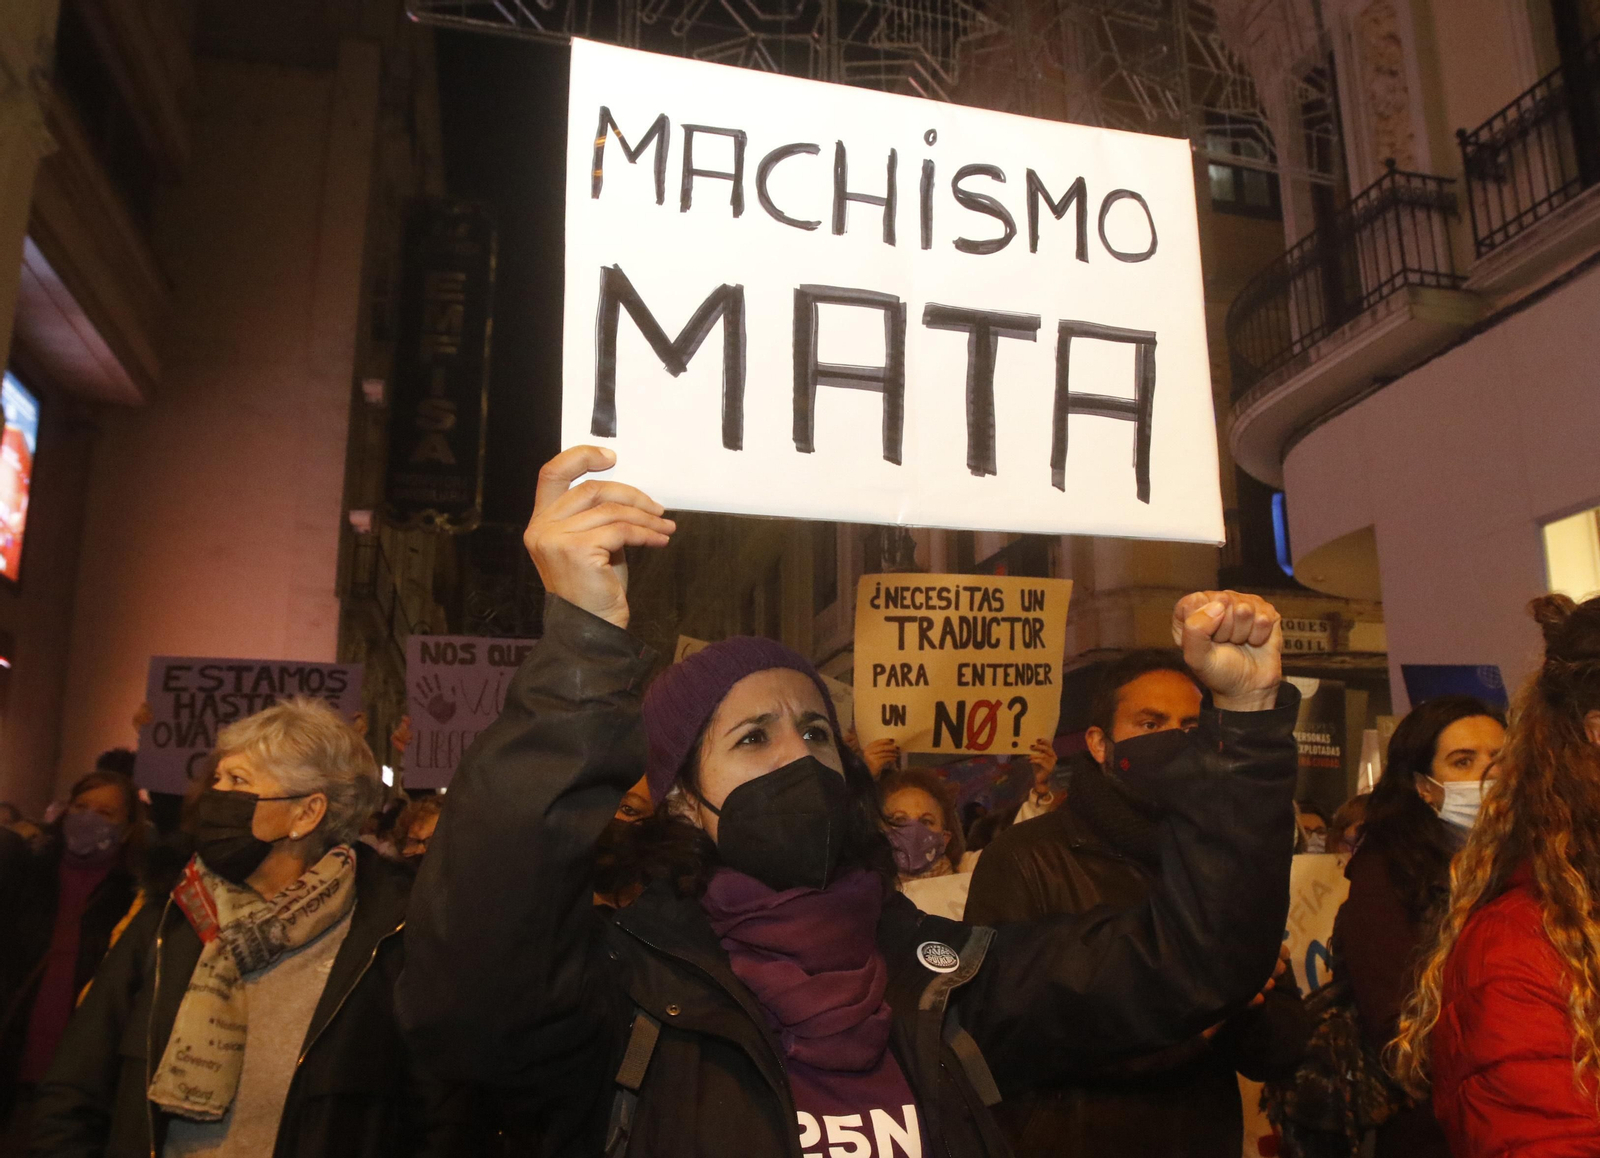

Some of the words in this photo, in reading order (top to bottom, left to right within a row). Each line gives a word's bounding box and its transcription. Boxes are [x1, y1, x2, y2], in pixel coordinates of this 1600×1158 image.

[591, 264, 1157, 504] MATA
[1020, 589, 1045, 612] UN
[884, 616, 1046, 651] TRADUCTOR
[420, 641, 476, 665] NOS
[163, 665, 349, 693] ESTAMOS
[872, 663, 929, 687] PARA
[957, 662, 1053, 687] ENTENDER
[881, 703, 906, 726] UN
